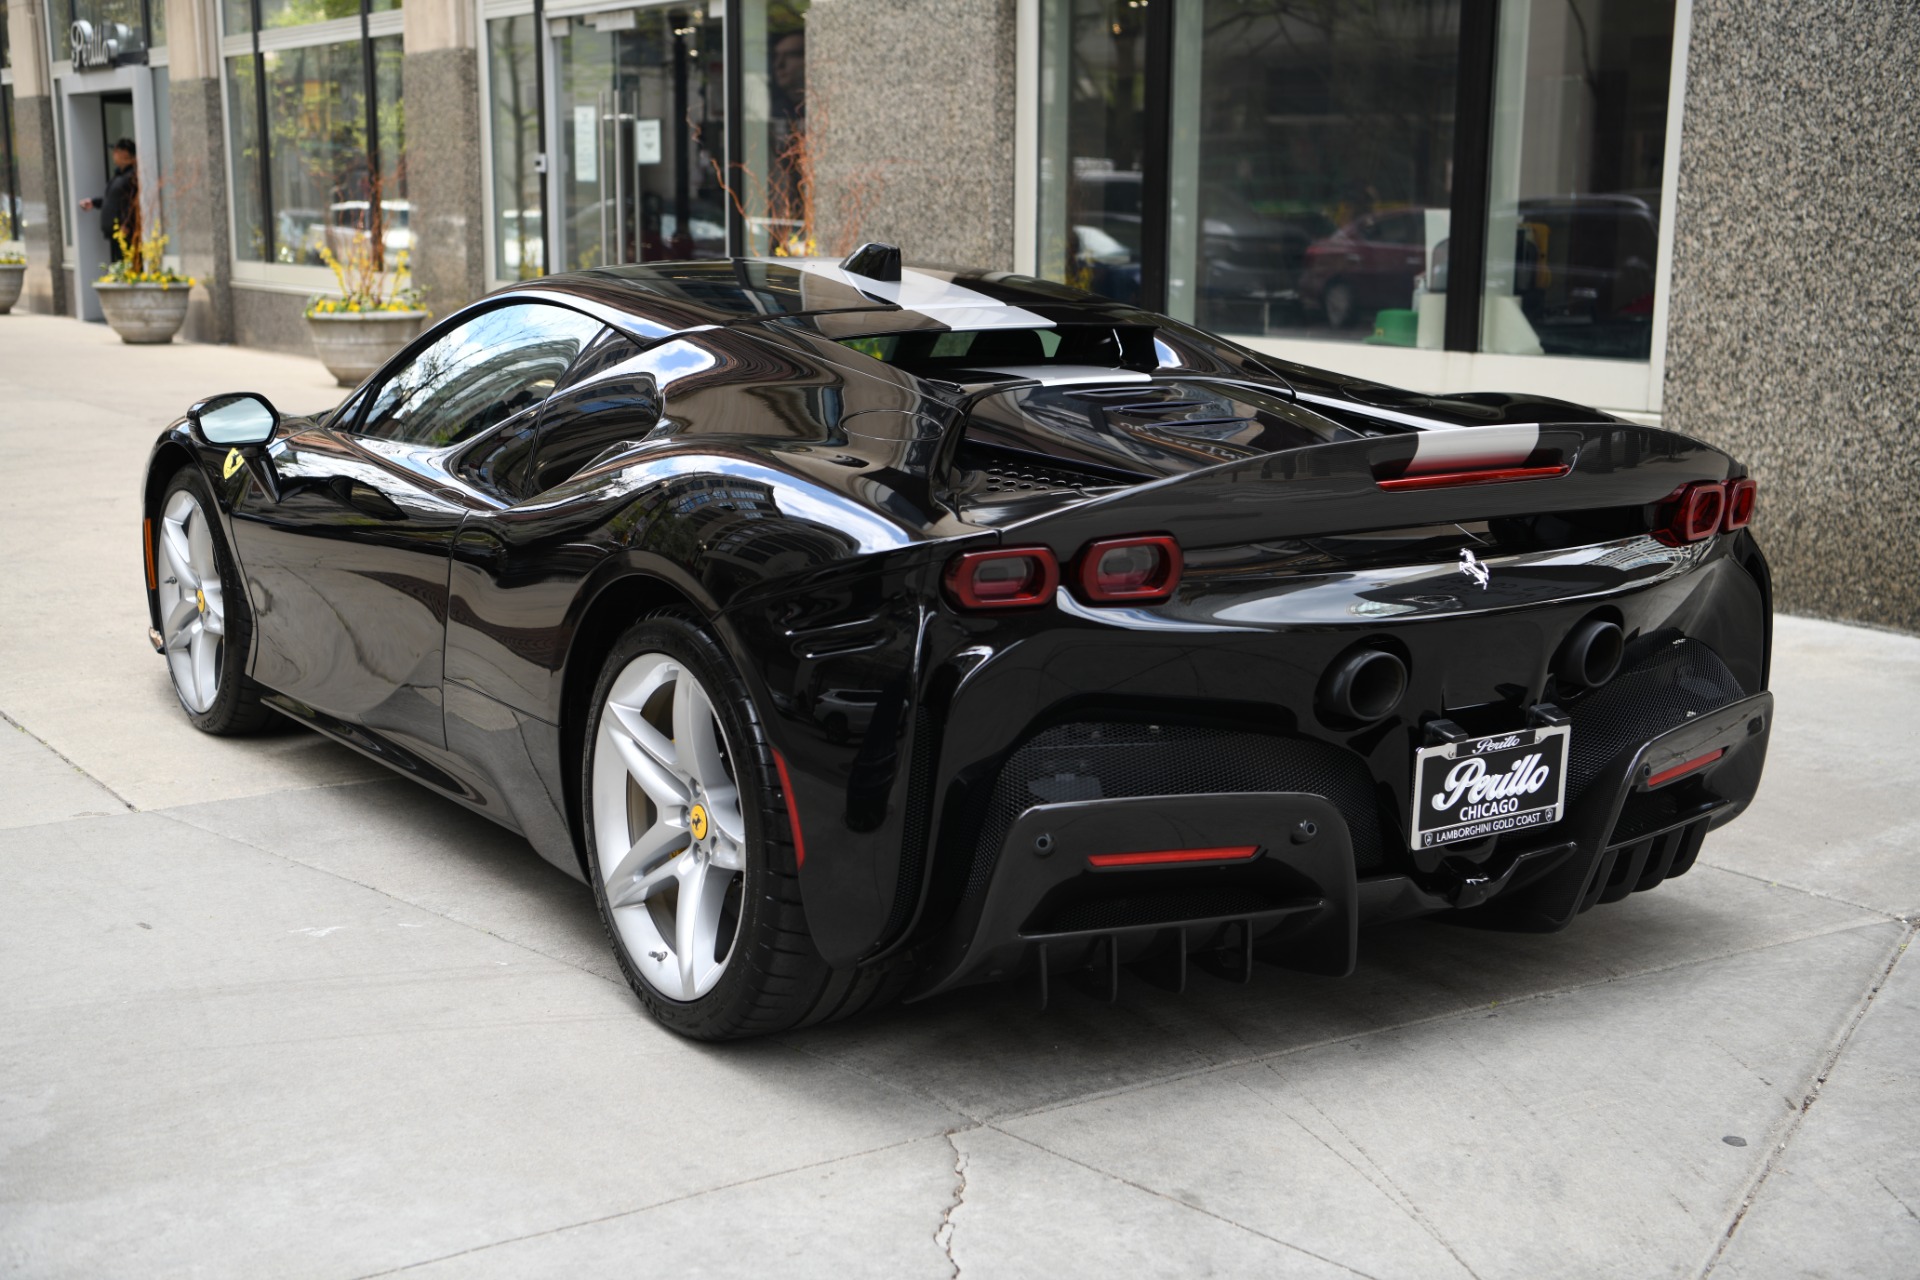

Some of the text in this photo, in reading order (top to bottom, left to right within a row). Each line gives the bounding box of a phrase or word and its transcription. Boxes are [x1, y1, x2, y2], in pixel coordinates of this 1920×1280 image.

[1472, 736, 1520, 754] Perillo
[1432, 753, 1549, 811] Perillo
[1460, 798, 1518, 821] CHICAGO
[1437, 813, 1541, 842] LAMBORGHINI GOLD COAST
